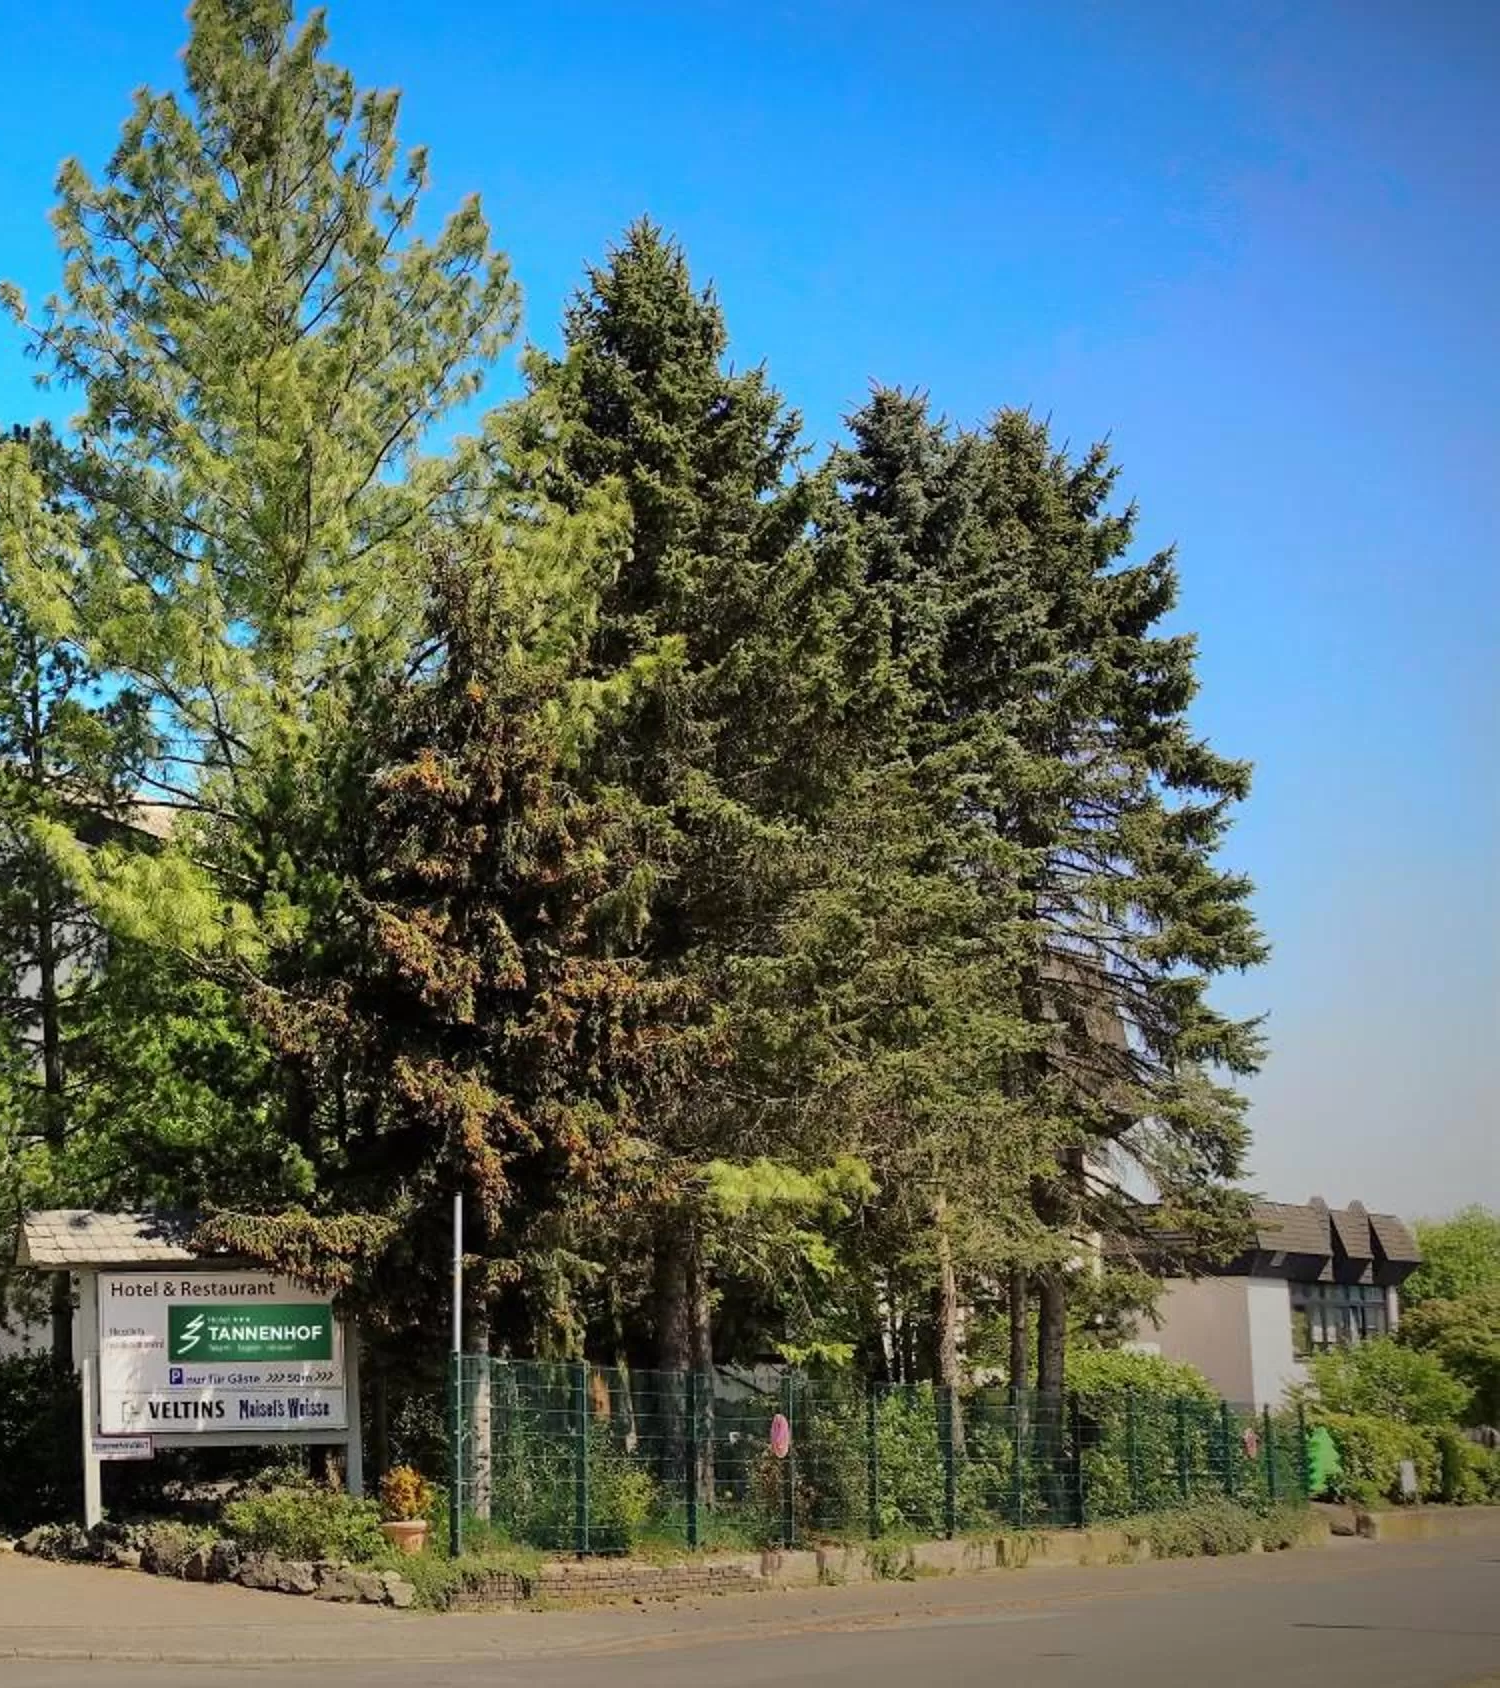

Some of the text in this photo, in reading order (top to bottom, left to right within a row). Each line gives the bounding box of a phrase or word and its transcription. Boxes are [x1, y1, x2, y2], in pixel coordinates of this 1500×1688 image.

[110, 1281, 276, 1297] Hotel & Restaurant
[208, 1325, 323, 1342] TANNENHOF
[186, 1375, 206, 1385] nur
[208, 1373, 226, 1385] für
[227, 1372, 261, 1385] Gäste
[149, 1400, 225, 1420] VELTINS
